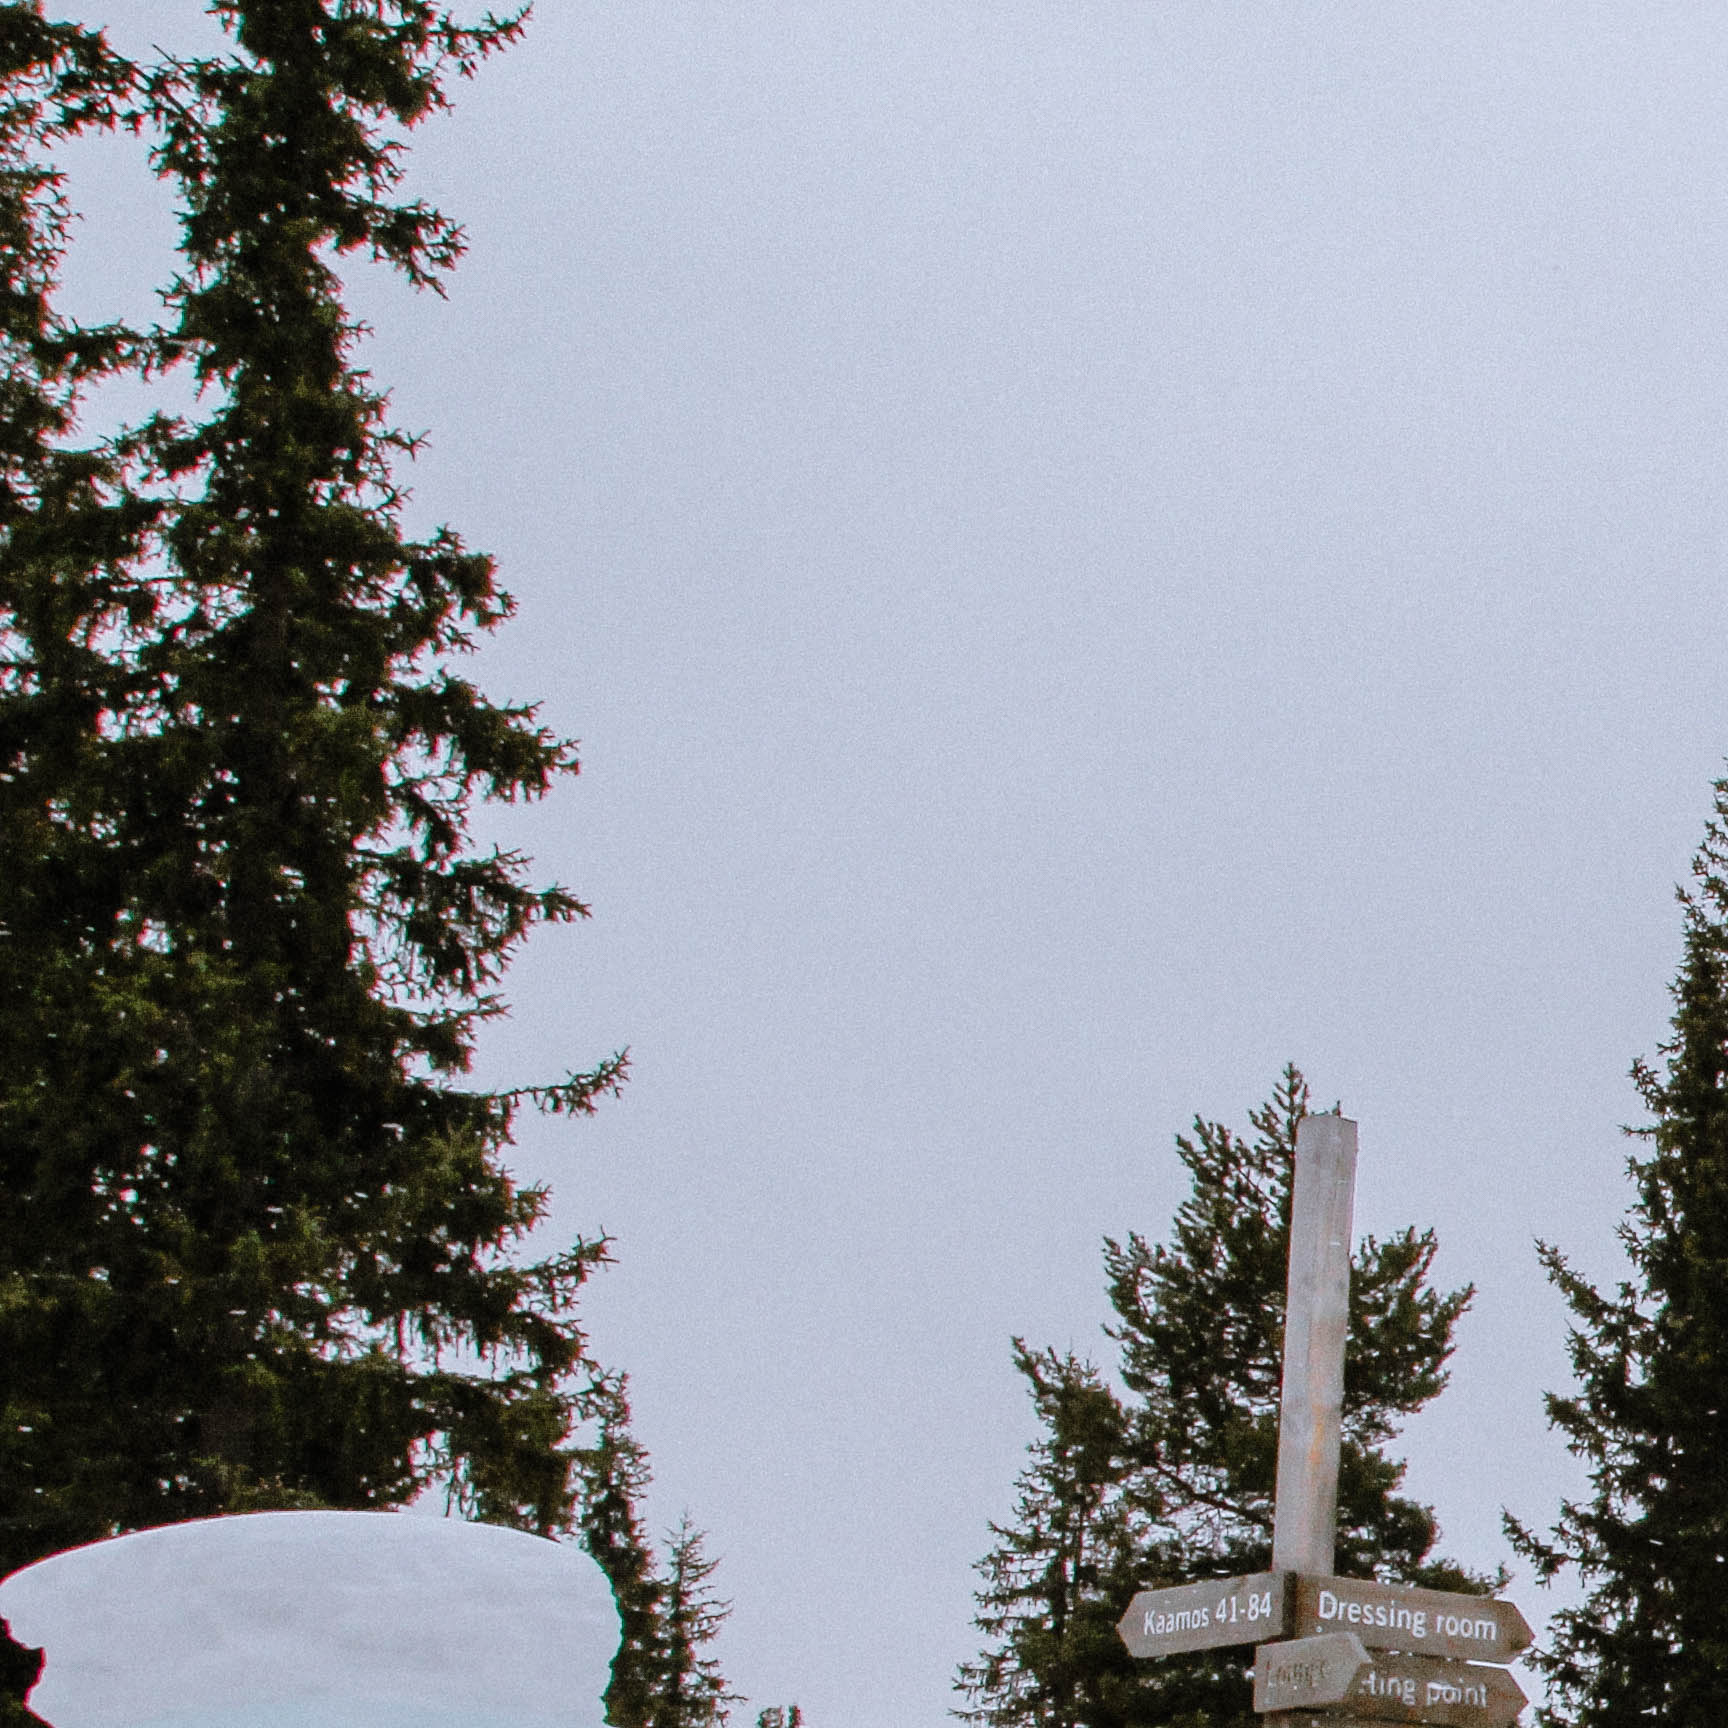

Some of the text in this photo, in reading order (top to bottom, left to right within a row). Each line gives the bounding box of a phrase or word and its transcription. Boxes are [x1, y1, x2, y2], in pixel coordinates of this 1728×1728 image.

[1143, 1591, 1272, 1636] Kaamos 41-84
[1318, 1589, 1498, 1641] Dressing room
[1359, 1670, 1417, 1706] ting
[1426, 1677, 1488, 1708] point
